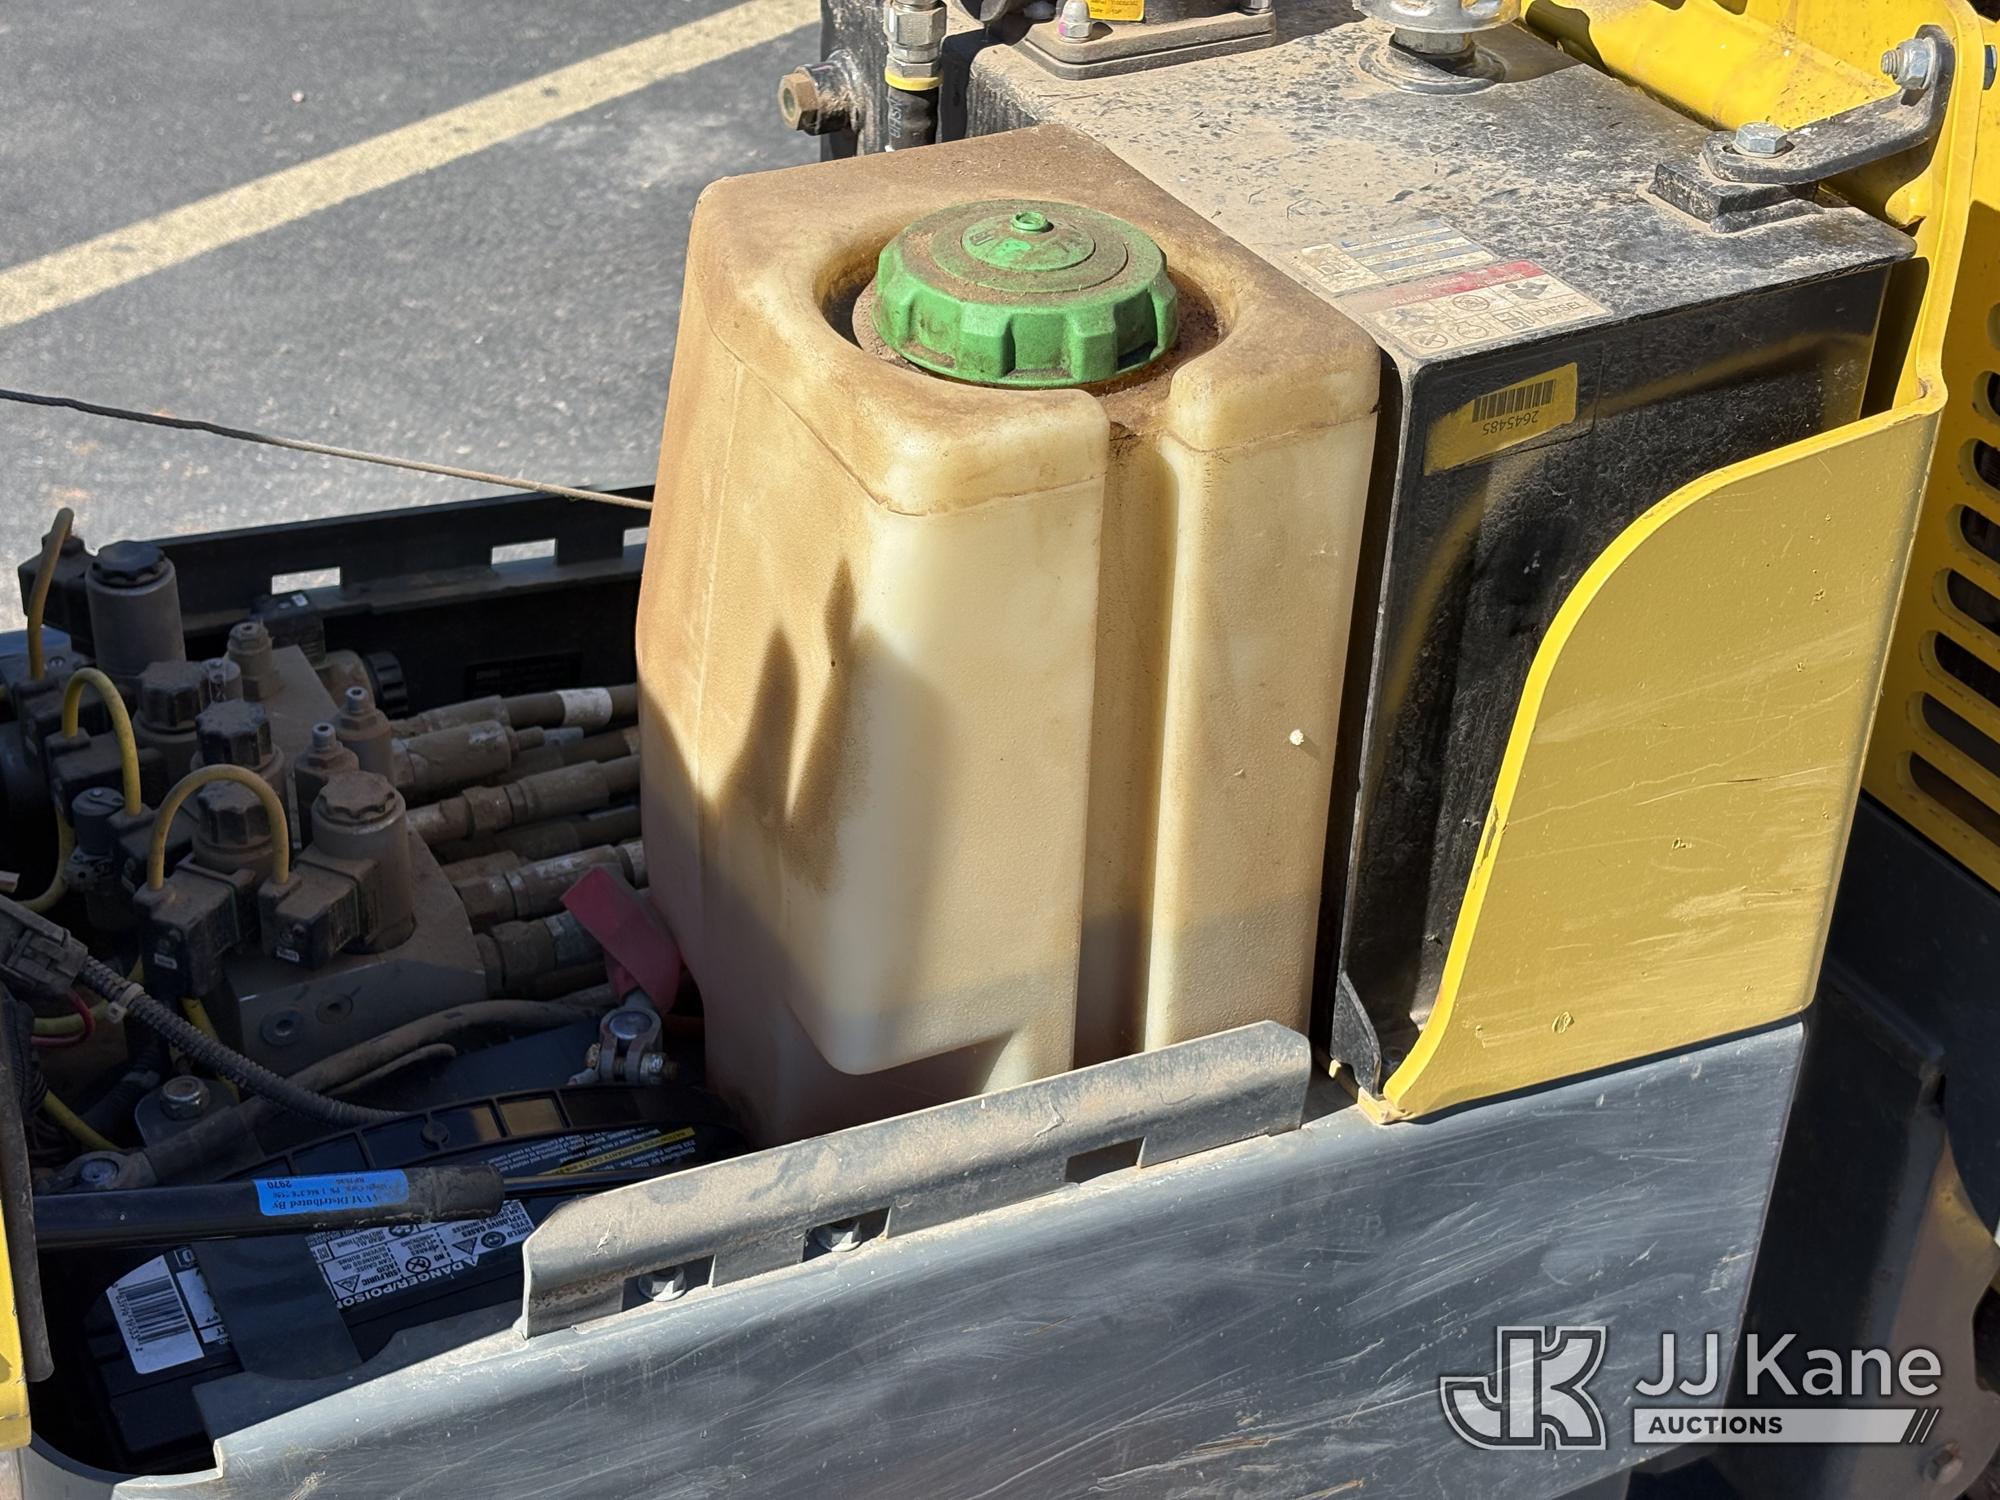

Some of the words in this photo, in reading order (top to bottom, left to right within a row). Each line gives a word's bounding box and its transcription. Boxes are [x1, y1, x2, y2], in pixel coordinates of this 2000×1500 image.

[1535, 302, 1587, 317] DIESEL
[1482, 410, 1539, 436] 2645485
[266, 1180, 292, 1189] 2970
[272, 1200, 285, 1210] By
[290, 1196, 349, 1209] Distributed
[489, 1213, 526, 1230] EXPLOSIVE
[462, 1226, 486, 1237] GASES
[507, 1227, 532, 1238] SHIELD
[433, 1254, 446, 1262] NO
[377, 1264, 395, 1273] ACID
[362, 1270, 398, 1285] SULFURIC
